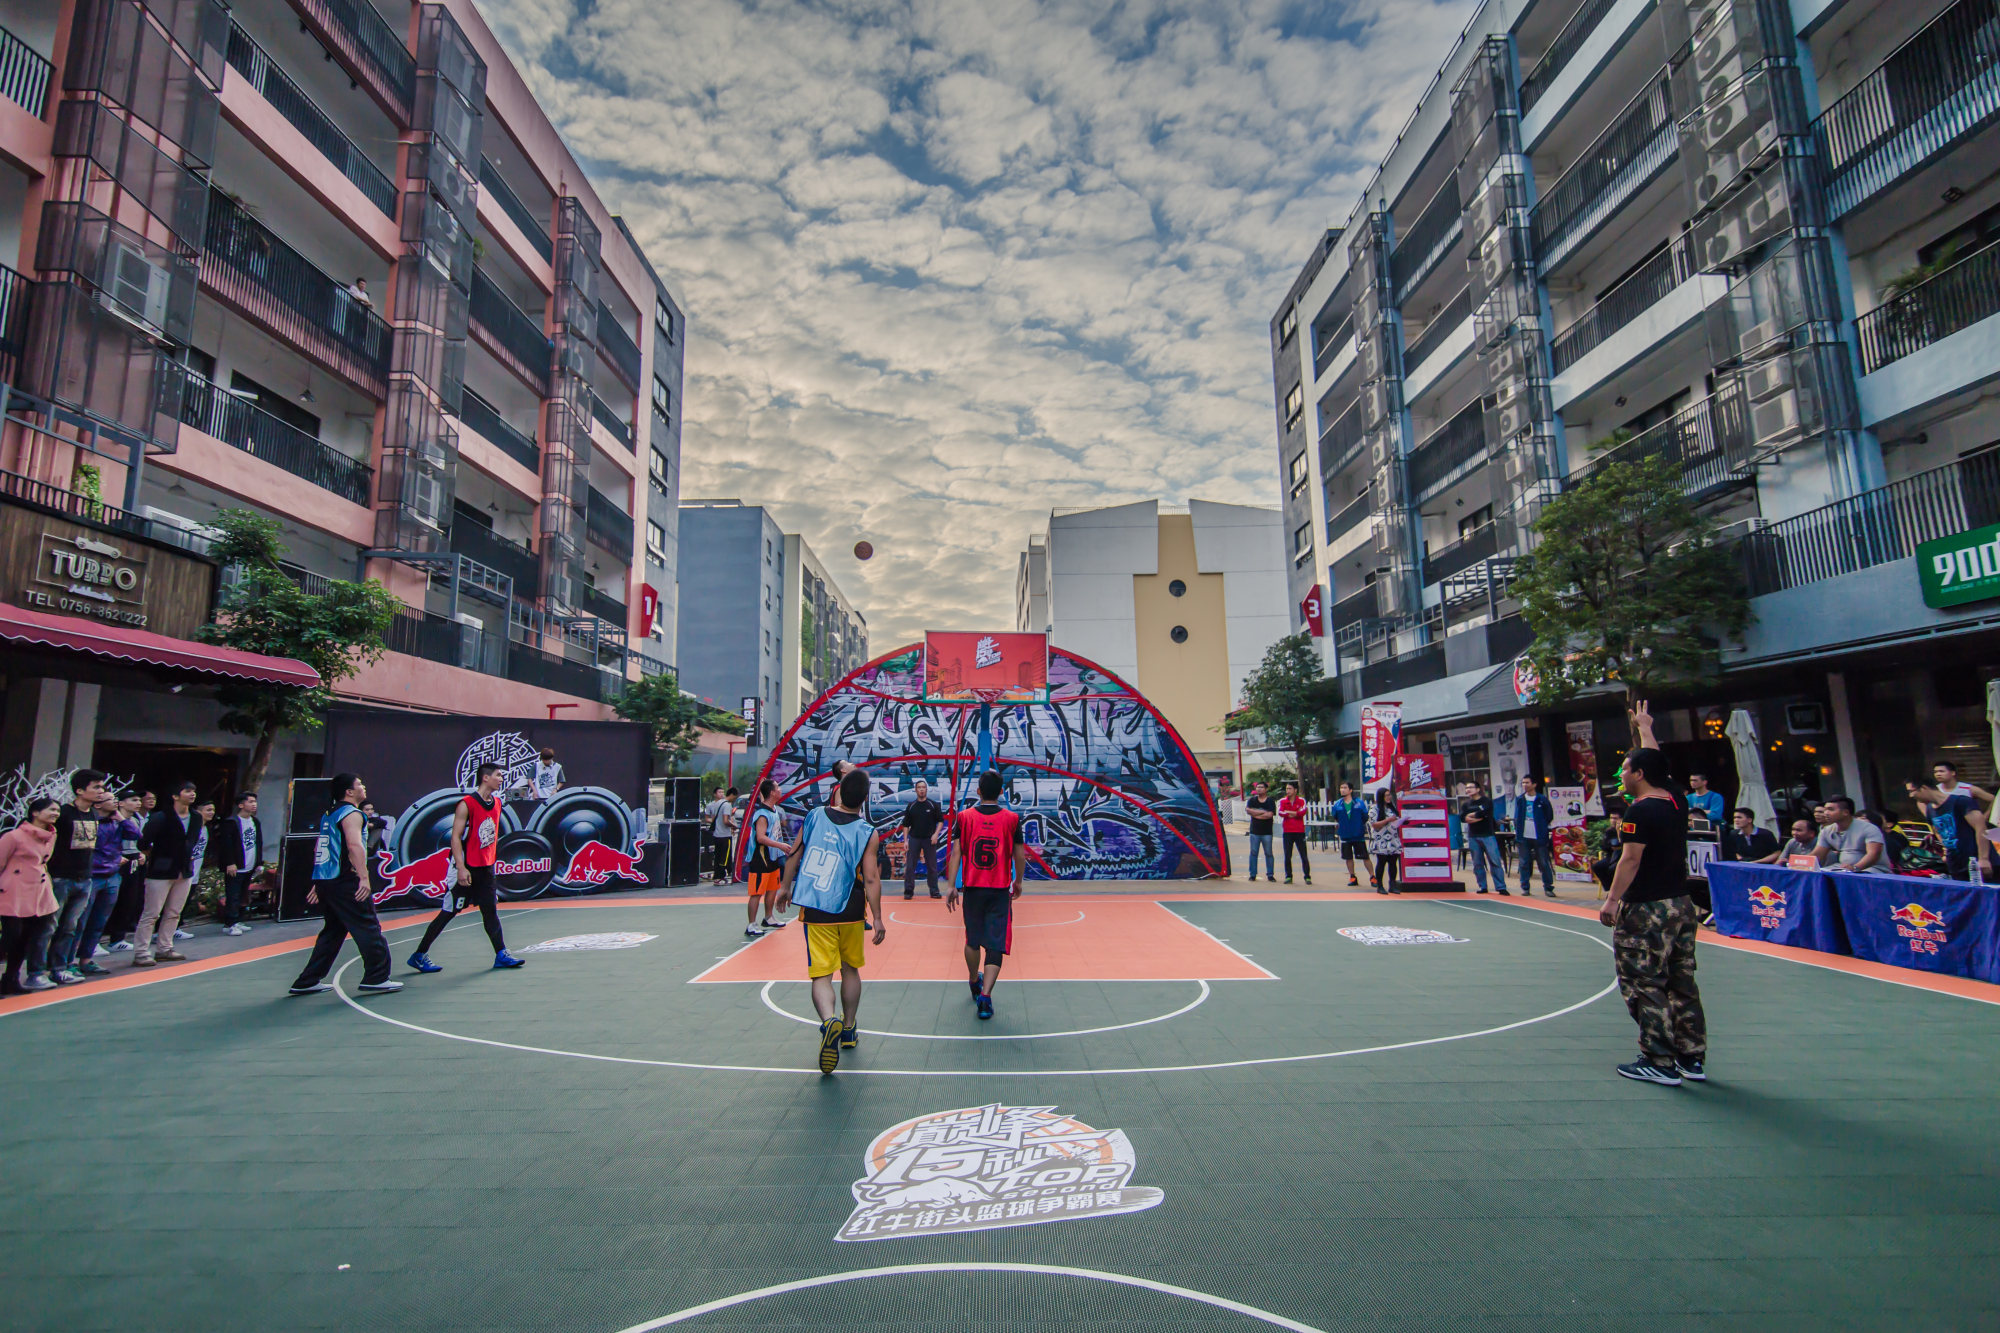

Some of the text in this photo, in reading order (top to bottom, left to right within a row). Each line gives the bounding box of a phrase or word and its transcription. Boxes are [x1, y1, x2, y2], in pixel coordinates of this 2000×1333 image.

[52, 549, 137, 590] TURBO
[26, 590, 56, 607] TEL
[60, 598, 148, 626] 0756-8620222
[645, 596, 652, 616] 1
[1308, 599, 1320, 618] 3
[971, 836, 999, 870] 6
[495, 858, 551, 875] RedBull
[802, 846, 840, 892] 4
[1897, 924, 1947, 943] RedBull
[1910, 939, 1939, 955] 红牛
[1002, 1177, 1119, 1200] second
[846, 1190, 1122, 1236] 红牛街头篮球争霸赛
